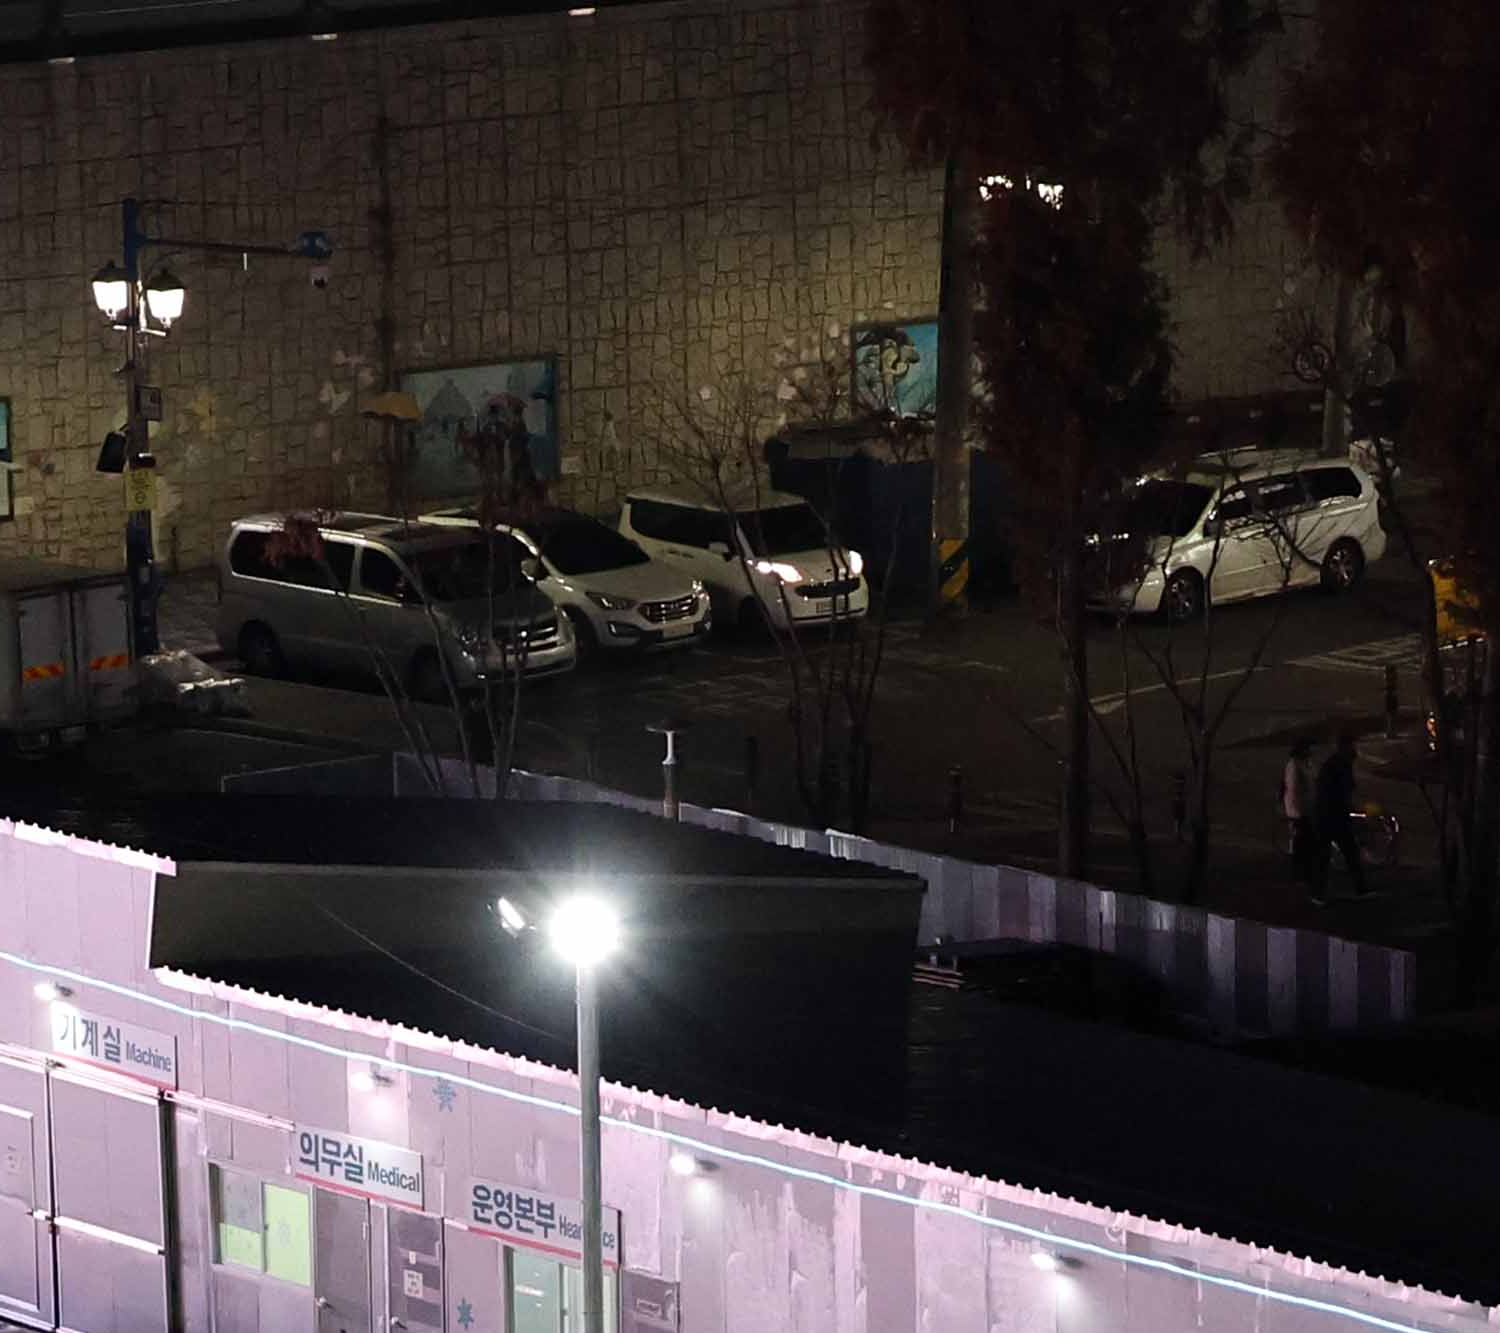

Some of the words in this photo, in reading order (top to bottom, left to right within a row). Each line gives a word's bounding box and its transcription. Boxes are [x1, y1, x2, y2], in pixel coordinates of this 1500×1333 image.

[60, 1014, 121, 1063] 기계실
[125, 1040, 172, 1073] Machine
[299, 1132, 364, 1184] 의무실
[367, 1160, 420, 1193] Medical
[471, 1184, 556, 1239] 운영본부
